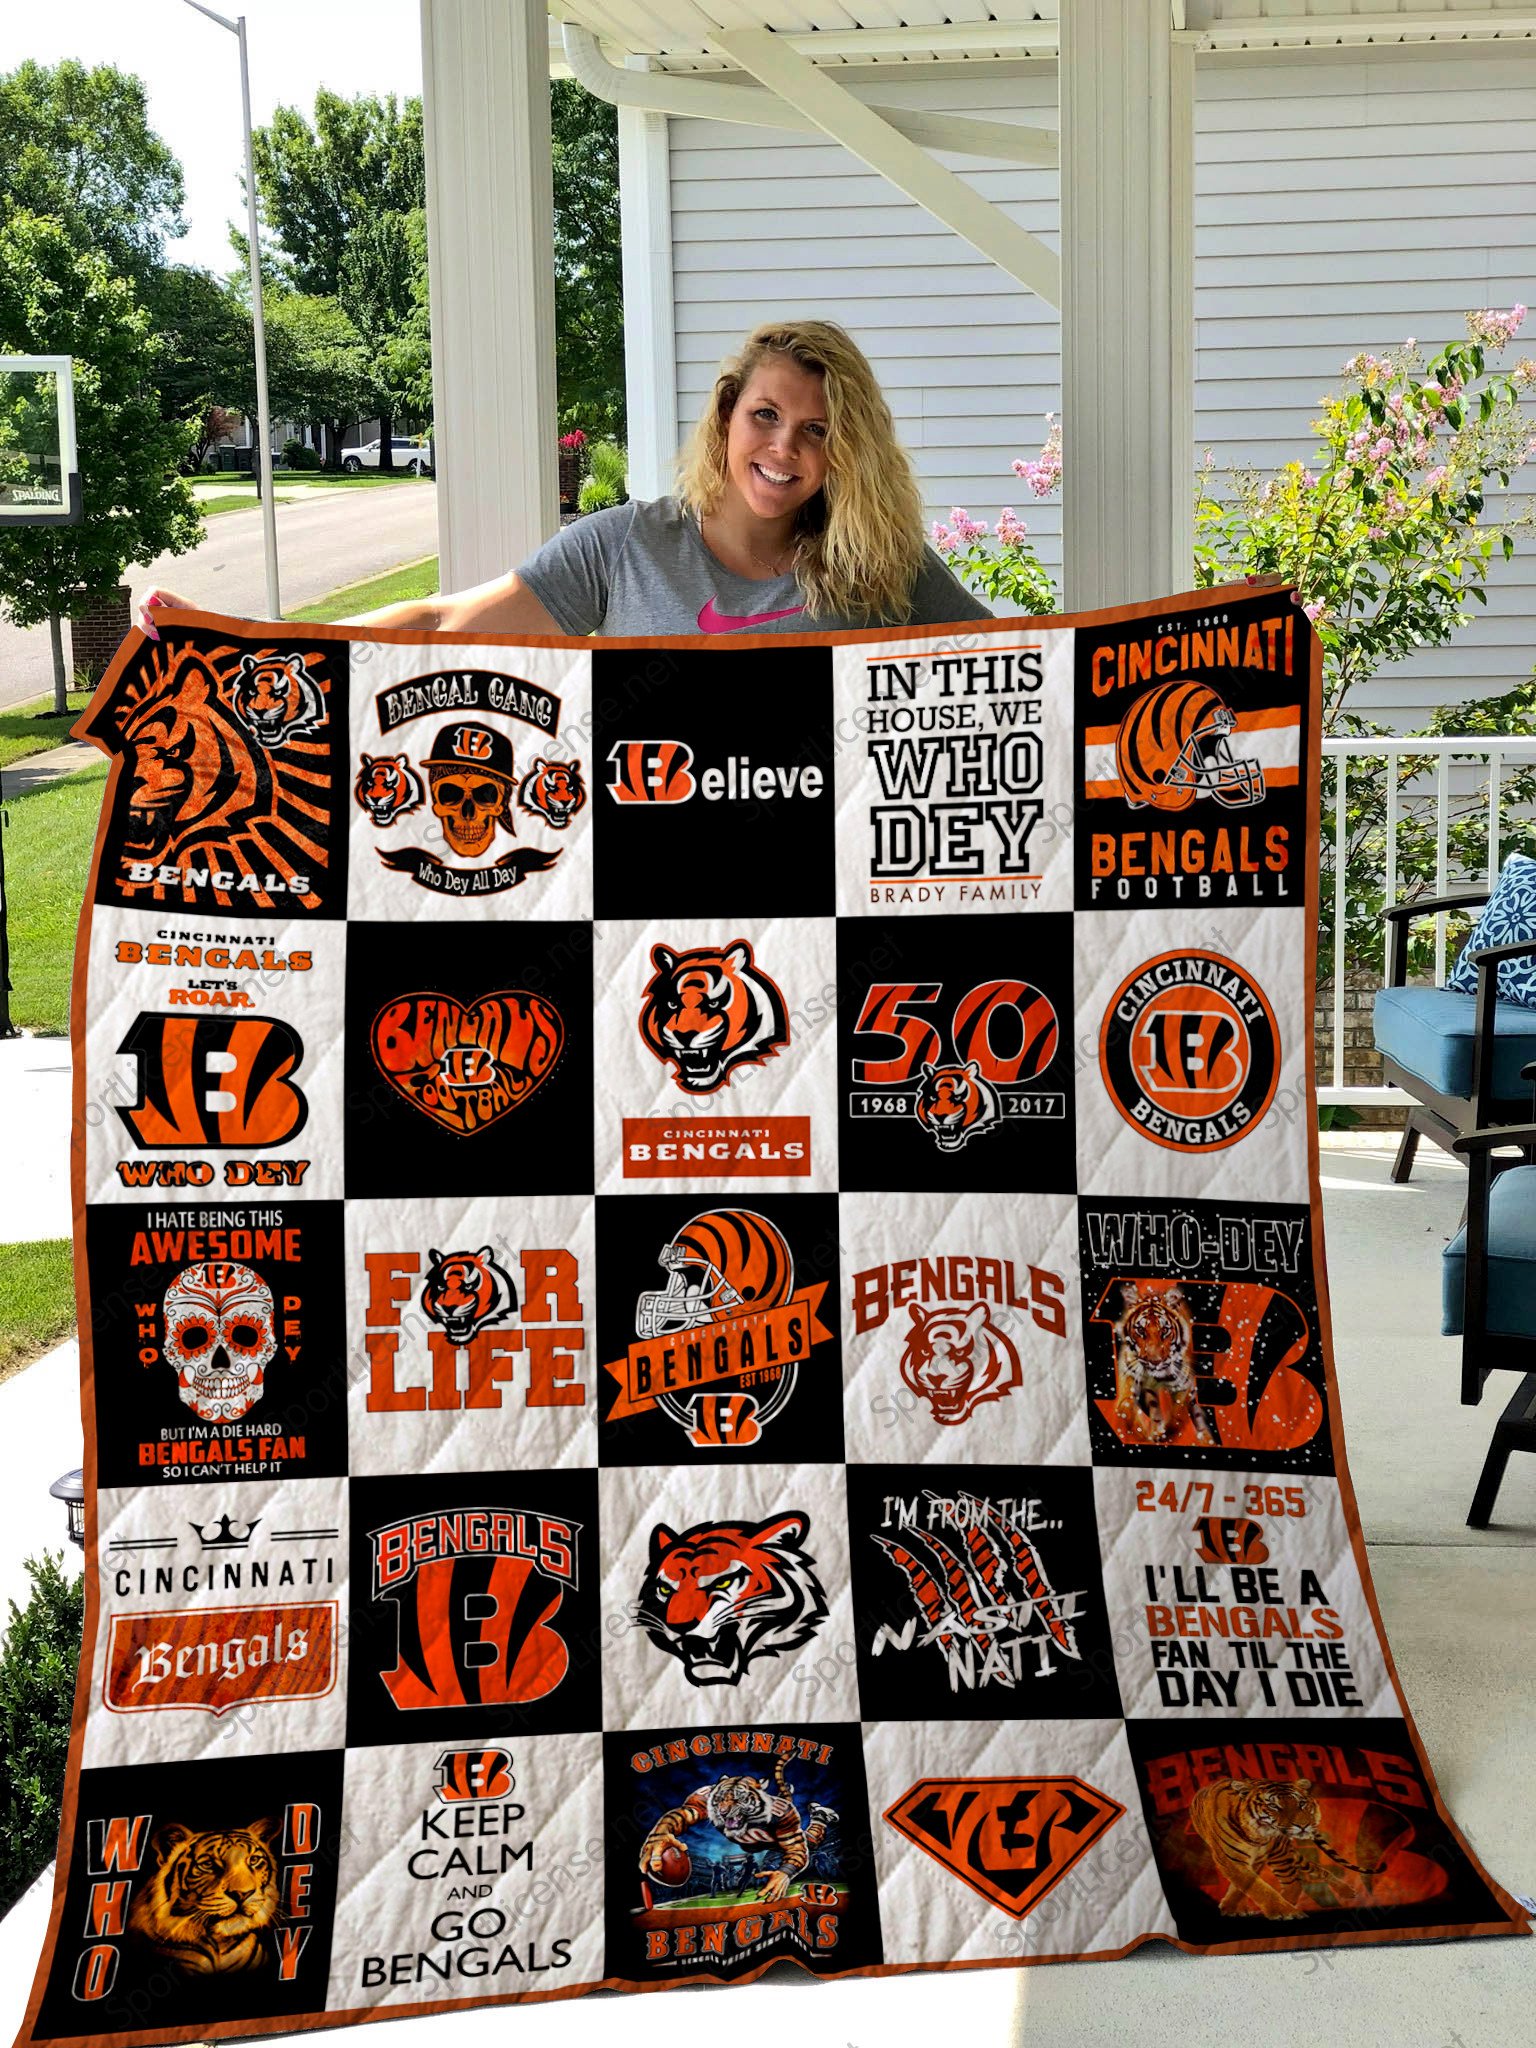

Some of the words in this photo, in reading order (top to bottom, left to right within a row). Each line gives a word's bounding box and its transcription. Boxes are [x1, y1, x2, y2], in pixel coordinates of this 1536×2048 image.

[12, 489, 59, 501] SPALDING
[1197, 614, 1228, 627] 1968
[1092, 614, 1294, 697] CINCINNATI
[867, 662, 917, 701] IN
[932, 653, 1043, 698] THIS
[385, 674, 479, 725] BENGAL
[488, 677, 552, 727] GANG
[867, 704, 985, 733] HOUSE,
[989, 700, 1042, 726] WE
[868, 732, 1043, 800] WHO
[870, 800, 1043, 878] DEY
[1092, 825, 1288, 877] BENGALS
[129, 863, 311, 896] BENGALS
[419, 862, 441, 886] Who
[445, 870, 469, 895] Dey
[472, 871, 490, 890] All
[492, 866, 517, 888] Day
[871, 886, 946, 903] BRADY
[960, 883, 1042, 901] FAMILY
[1092, 873, 1288, 899] FOOTBALL
[115, 941, 313, 971] BENGALS
[156, 929, 276, 946] CINCINNATI
[188, 979, 238, 991] LET'S
[1116, 959, 1264, 1023] CINCINNATI
[377, 998, 558, 1077] BENGALS
[852, 979, 1059, 1085] 50
[861, 1098, 907, 1114] 1968
[1008, 1098, 1055, 1114] 2017
[1130, 1096, 1252, 1144] BENGALS
[629, 1142, 805, 1162] BENGALS
[663, 1129, 770, 1139] CINCINNATI
[116, 1161, 215, 1187] WHO
[224, 1160, 311, 1187] DEY
[147, 1212, 152, 1229] I
[156, 1211, 196, 1229] HATE
[200, 1210, 246, 1228] BEING
[249, 1209, 283, 1227] THIS
[130, 1228, 302, 1267] AWESOME
[1086, 1212, 1304, 1274] WHO-DEY
[852, 1255, 1067, 1339] BENGALS
[365, 1328, 586, 1413] LIFE
[636, 1317, 804, 1395] BENGALS
[740, 1372, 756, 1389] EST
[759, 1366, 782, 1384] 1968
[138, 1438, 253, 1466] BENGALS
[259, 1436, 306, 1460] FAN
[160, 1427, 186, 1441] BUT
[188, 1426, 208, 1440] I'M
[210, 1425, 220, 1439] A
[222, 1424, 243, 1438] DIE
[245, 1423, 282, 1437] HARD
[162, 1466, 182, 1479] SO
[191, 1463, 231, 1477] CAN'T
[234, 1462, 268, 1475] HELP
[270, 1461, 283, 1473] IT
[881, 1496, 919, 1531] I'M
[927, 1496, 990, 1531] FROM
[1136, 1480, 1214, 1513] 24/7
[1244, 1485, 1306, 1518] 365
[376, 1512, 573, 1588] BENGALS
[115, 1557, 333, 1597] CINCINNATI
[1145, 1565, 1220, 1603] I'LL
[1231, 1567, 1284, 1604] BE
[1301, 1569, 1330, 1606] A
[1146, 1605, 1344, 1640] BENGALS
[131, 1622, 310, 1693] Bengals
[1151, 1641, 1211, 1668] FAN
[1228, 1641, 1278, 1669] TIL
[1286, 1642, 1350, 1669] THE
[1156, 1670, 1240, 1708] DAY
[1258, 1670, 1277, 1707] I
[1285, 1671, 1364, 1707] DIE
[630, 1731, 834, 1773] CINCINNATI
[1144, 1743, 1428, 1816] BENGALS
[421, 1803, 525, 1841] KEEP
[407, 1841, 534, 1880] CALM
[447, 1884, 493, 1901] AND
[430, 1908, 506, 1942] GO
[646, 1906, 840, 1960] BENGALS
[361, 1938, 573, 1988] BENGALS
